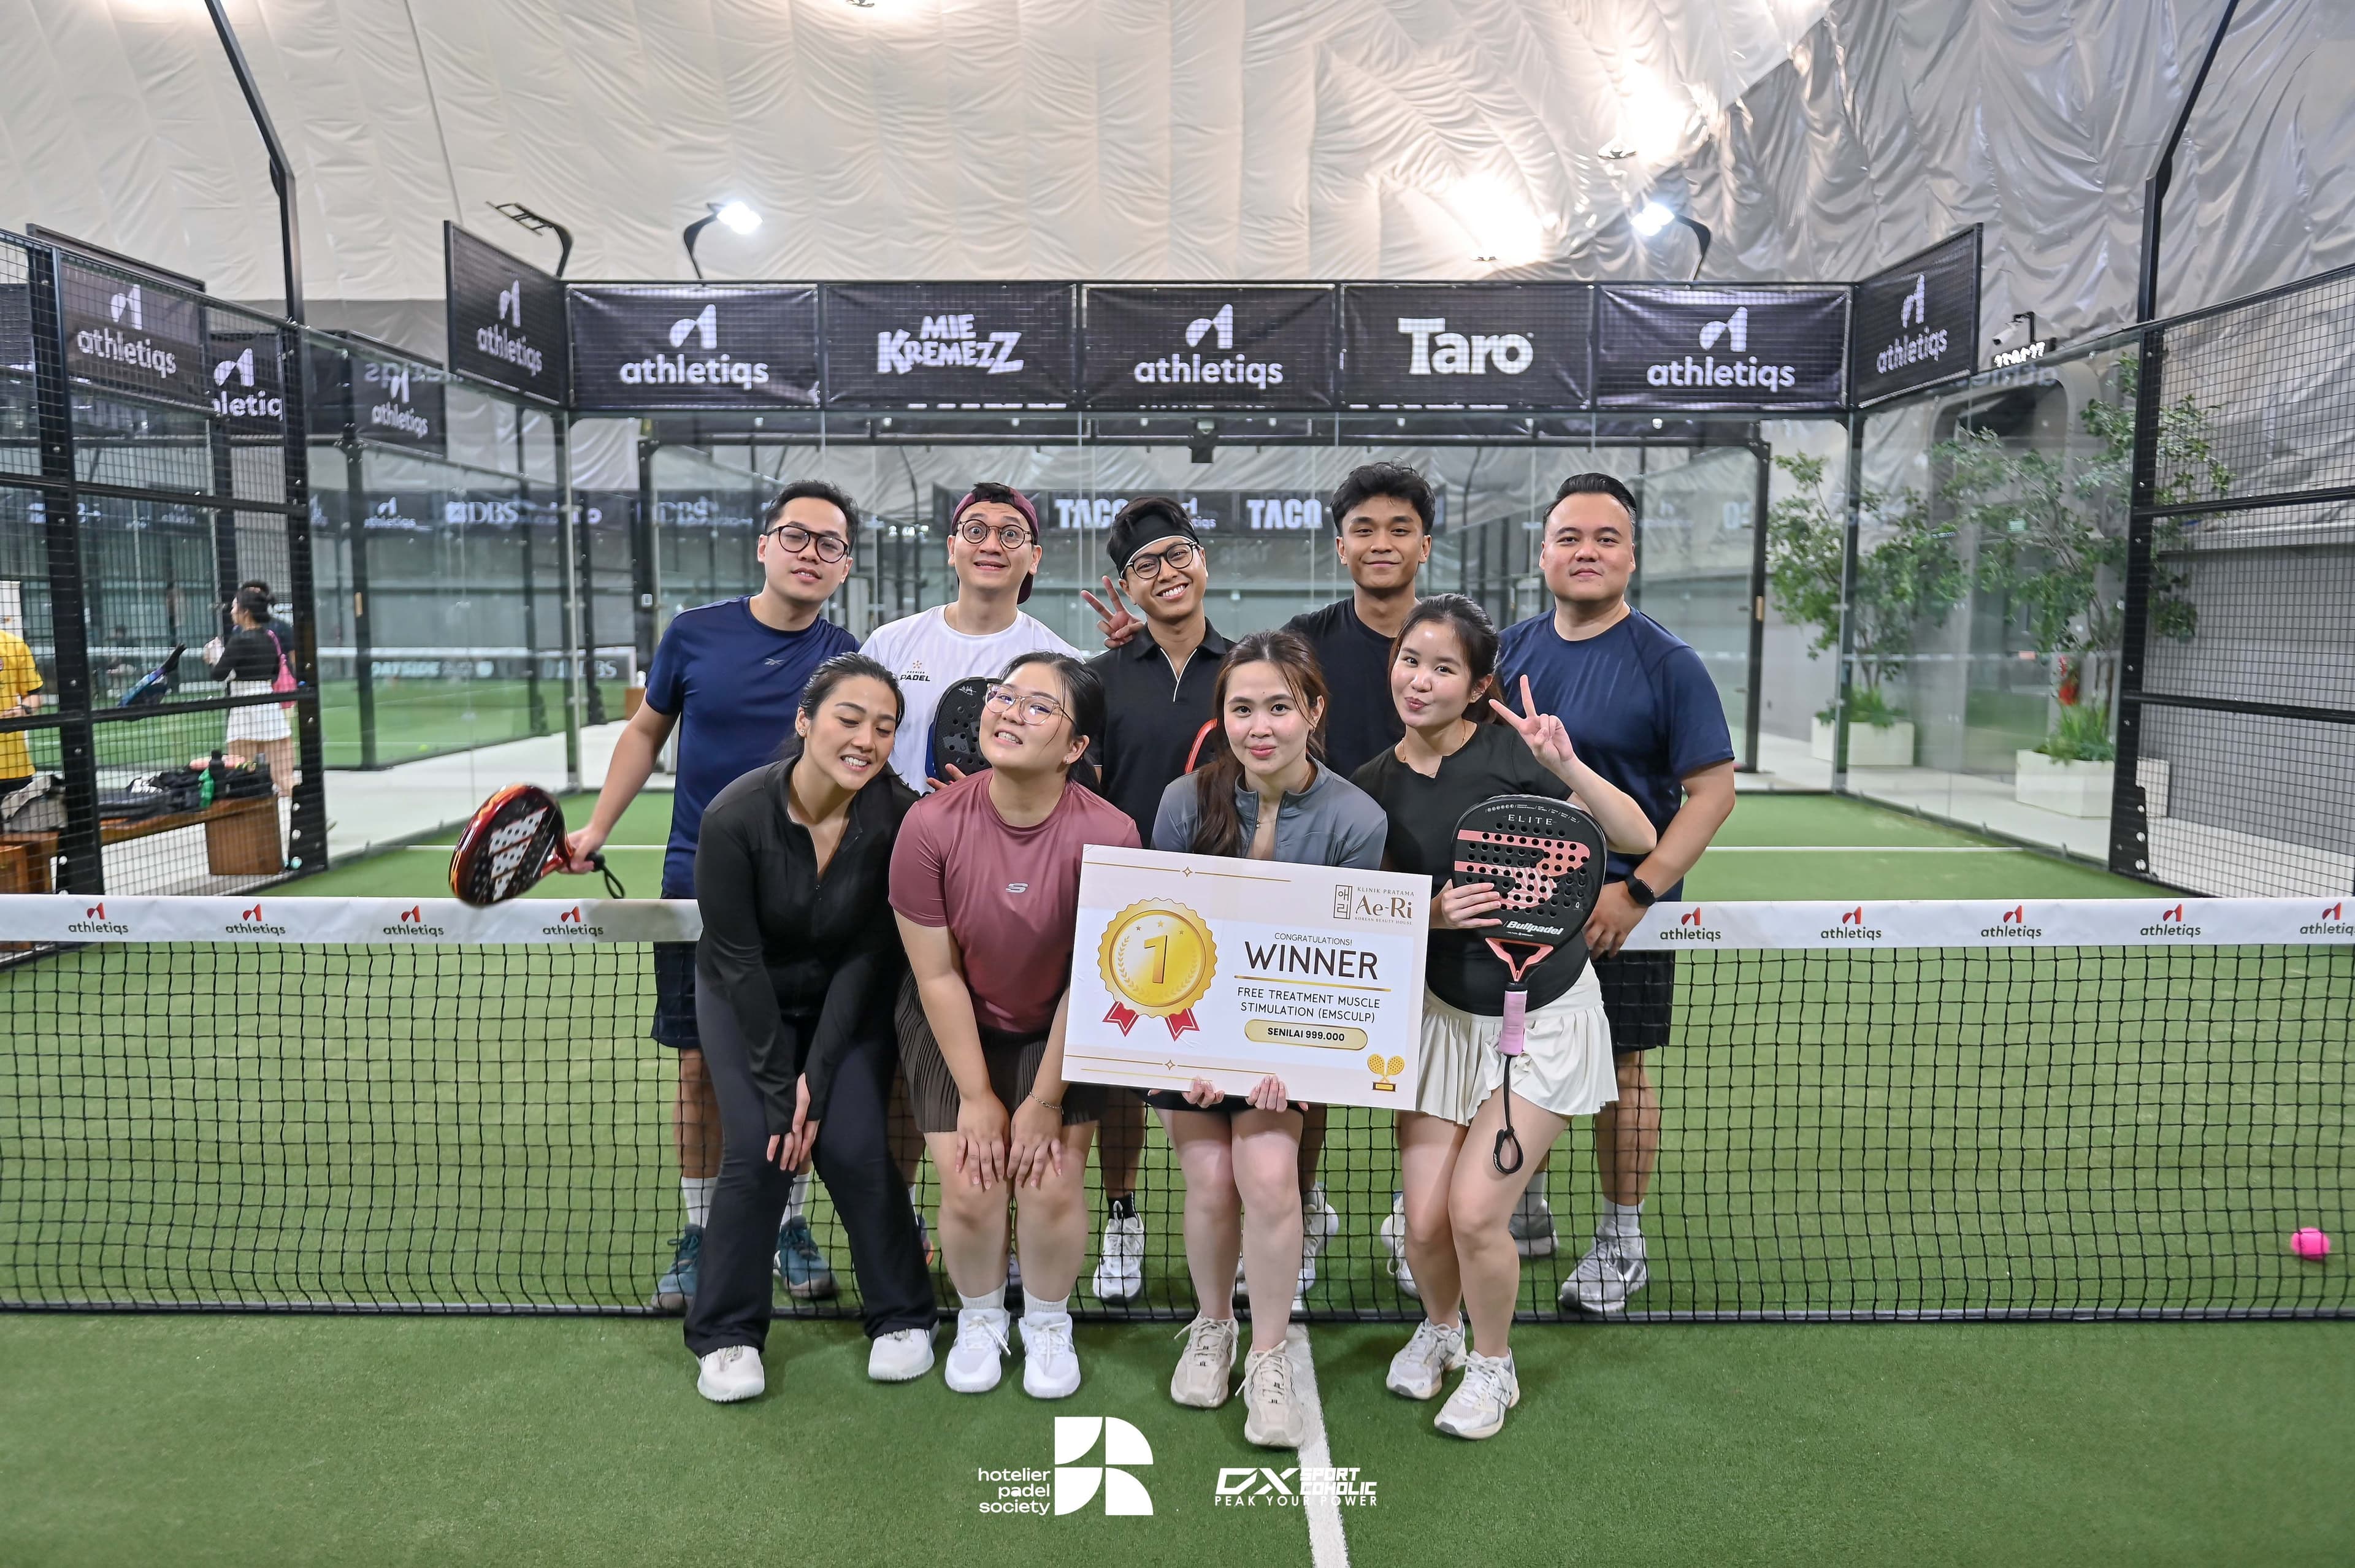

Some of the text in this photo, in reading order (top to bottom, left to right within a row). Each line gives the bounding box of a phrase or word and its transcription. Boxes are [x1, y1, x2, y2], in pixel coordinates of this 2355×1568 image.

[920, 314, 976, 340] MIE
[77, 328, 177, 379] athletiqs
[477, 324, 542, 377] athletiqs
[1398, 318, 1533, 375] Taro
[1876, 326, 1948, 374] athletiqs
[619, 353, 770, 390] athletiqs
[1133, 353, 1284, 389] athletiqs
[1646, 356, 1796, 392] athletiqs
[372, 402, 428, 438] athletiqs
[1246, 499, 1322, 530] TACO
[1508, 814, 1553, 825] ELITE
[1337, 889, 1349, 919] 애리
[1355, 895, 1412, 919] Ae-Ri
[69, 922, 129, 933] athletiqs
[226, 923, 286, 936] athletiqs
[383, 924, 444, 936] athletiqs
[542, 924, 604, 937] athletiqs
[1507, 921, 1564, 935] Bullpadel
[1660, 928, 1721, 942] athletiqs
[1821, 927, 1882, 941] athletiqs
[1980, 925, 2042, 938] athletiqs
[2140, 924, 2201, 936] athletiqs
[2300, 922, 2355, 936] athletiq
[1274, 933, 1352, 946] CONGRATULATIONS!
[1144, 935, 1168, 984] 1
[1244, 941, 1378, 980] WINNER
[1238, 987, 1380, 1008] FREE TREATMENT MUSCLE
[1241, 1002, 1375, 1023] STIMULATION (EMSCULP)
[1268, 1028, 1345, 1041] SENILAI 999.000
